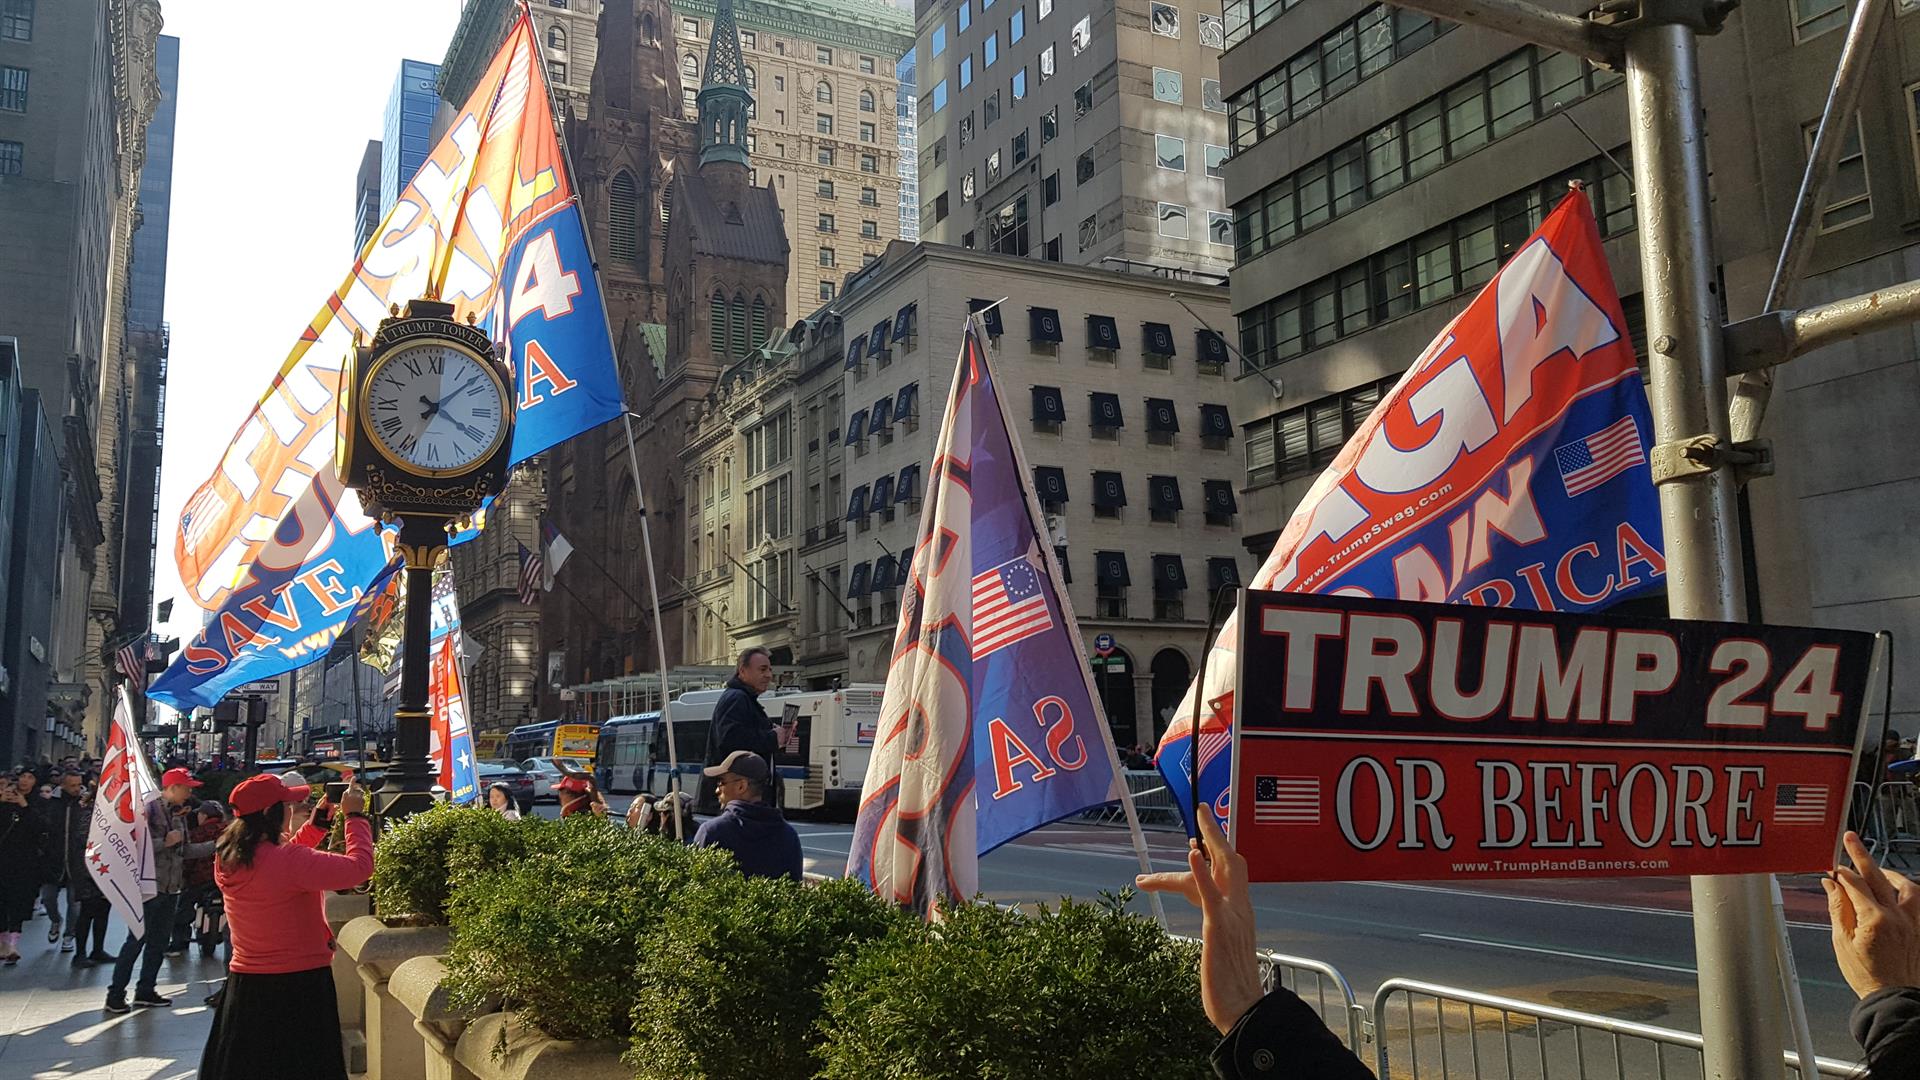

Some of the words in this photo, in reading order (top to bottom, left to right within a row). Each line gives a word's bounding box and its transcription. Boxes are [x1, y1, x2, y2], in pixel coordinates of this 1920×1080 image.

[389, 322, 435, 338] TRUMP
[441, 324, 484, 348] TOWER
[403, 358, 423, 379] XI
[428, 356, 445, 375] XII
[385, 374, 406, 391] X
[472, 408, 491, 418] III
[184, 559, 363, 675] SAVE
[1260, 605, 1680, 724] TRUMP
[1705, 638, 1842, 731] 24
[1336, 756, 1454, 850] OR
[1476, 761, 1765, 849] BEFORE
[108, 833, 135, 868] GREAT
[1452, 859, 1669, 873] www.TrumpHandBanners.com
